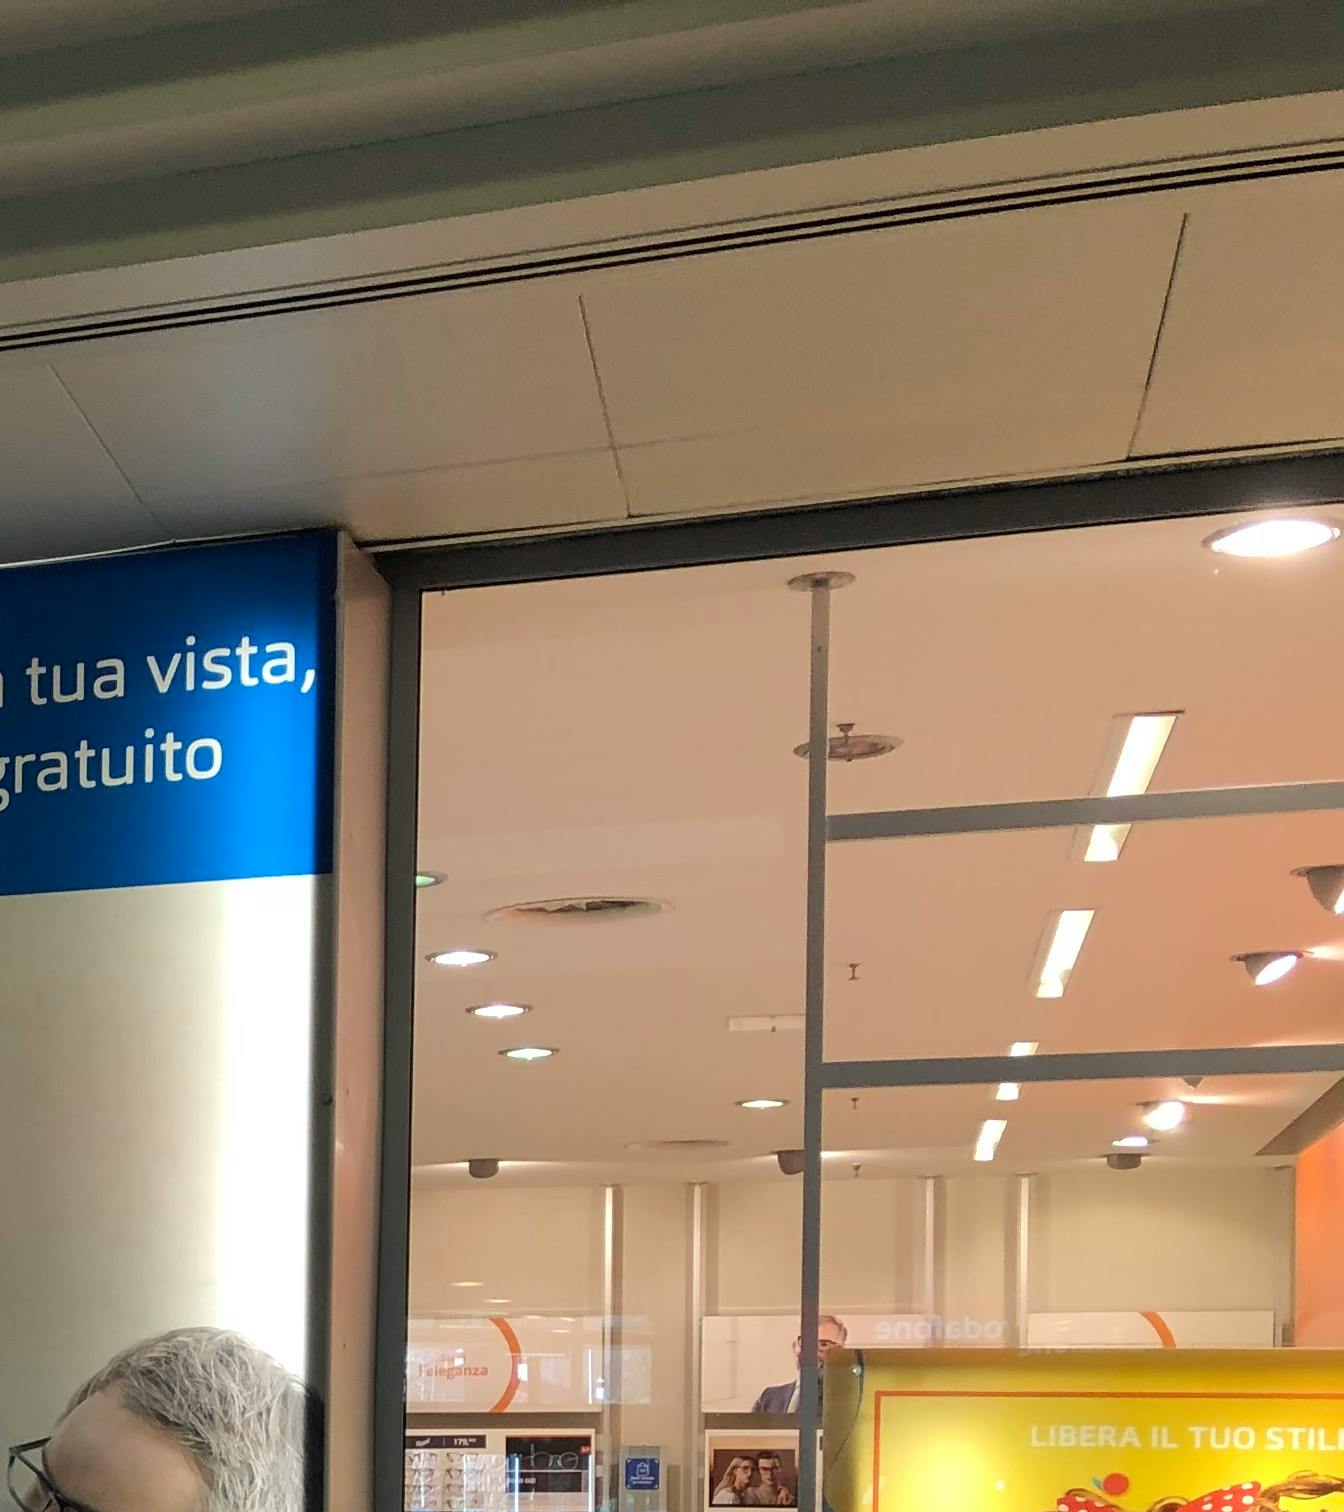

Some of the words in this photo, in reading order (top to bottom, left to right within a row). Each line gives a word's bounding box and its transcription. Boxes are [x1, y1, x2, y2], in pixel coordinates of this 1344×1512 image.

[26, 656, 125, 707] tua
[146, 635, 317, 695] vista,
[1030, 1423, 1142, 1449] LIBERA
[1150, 1424, 1178, 1449] IL
[1187, 1424, 1257, 1451] TUO
